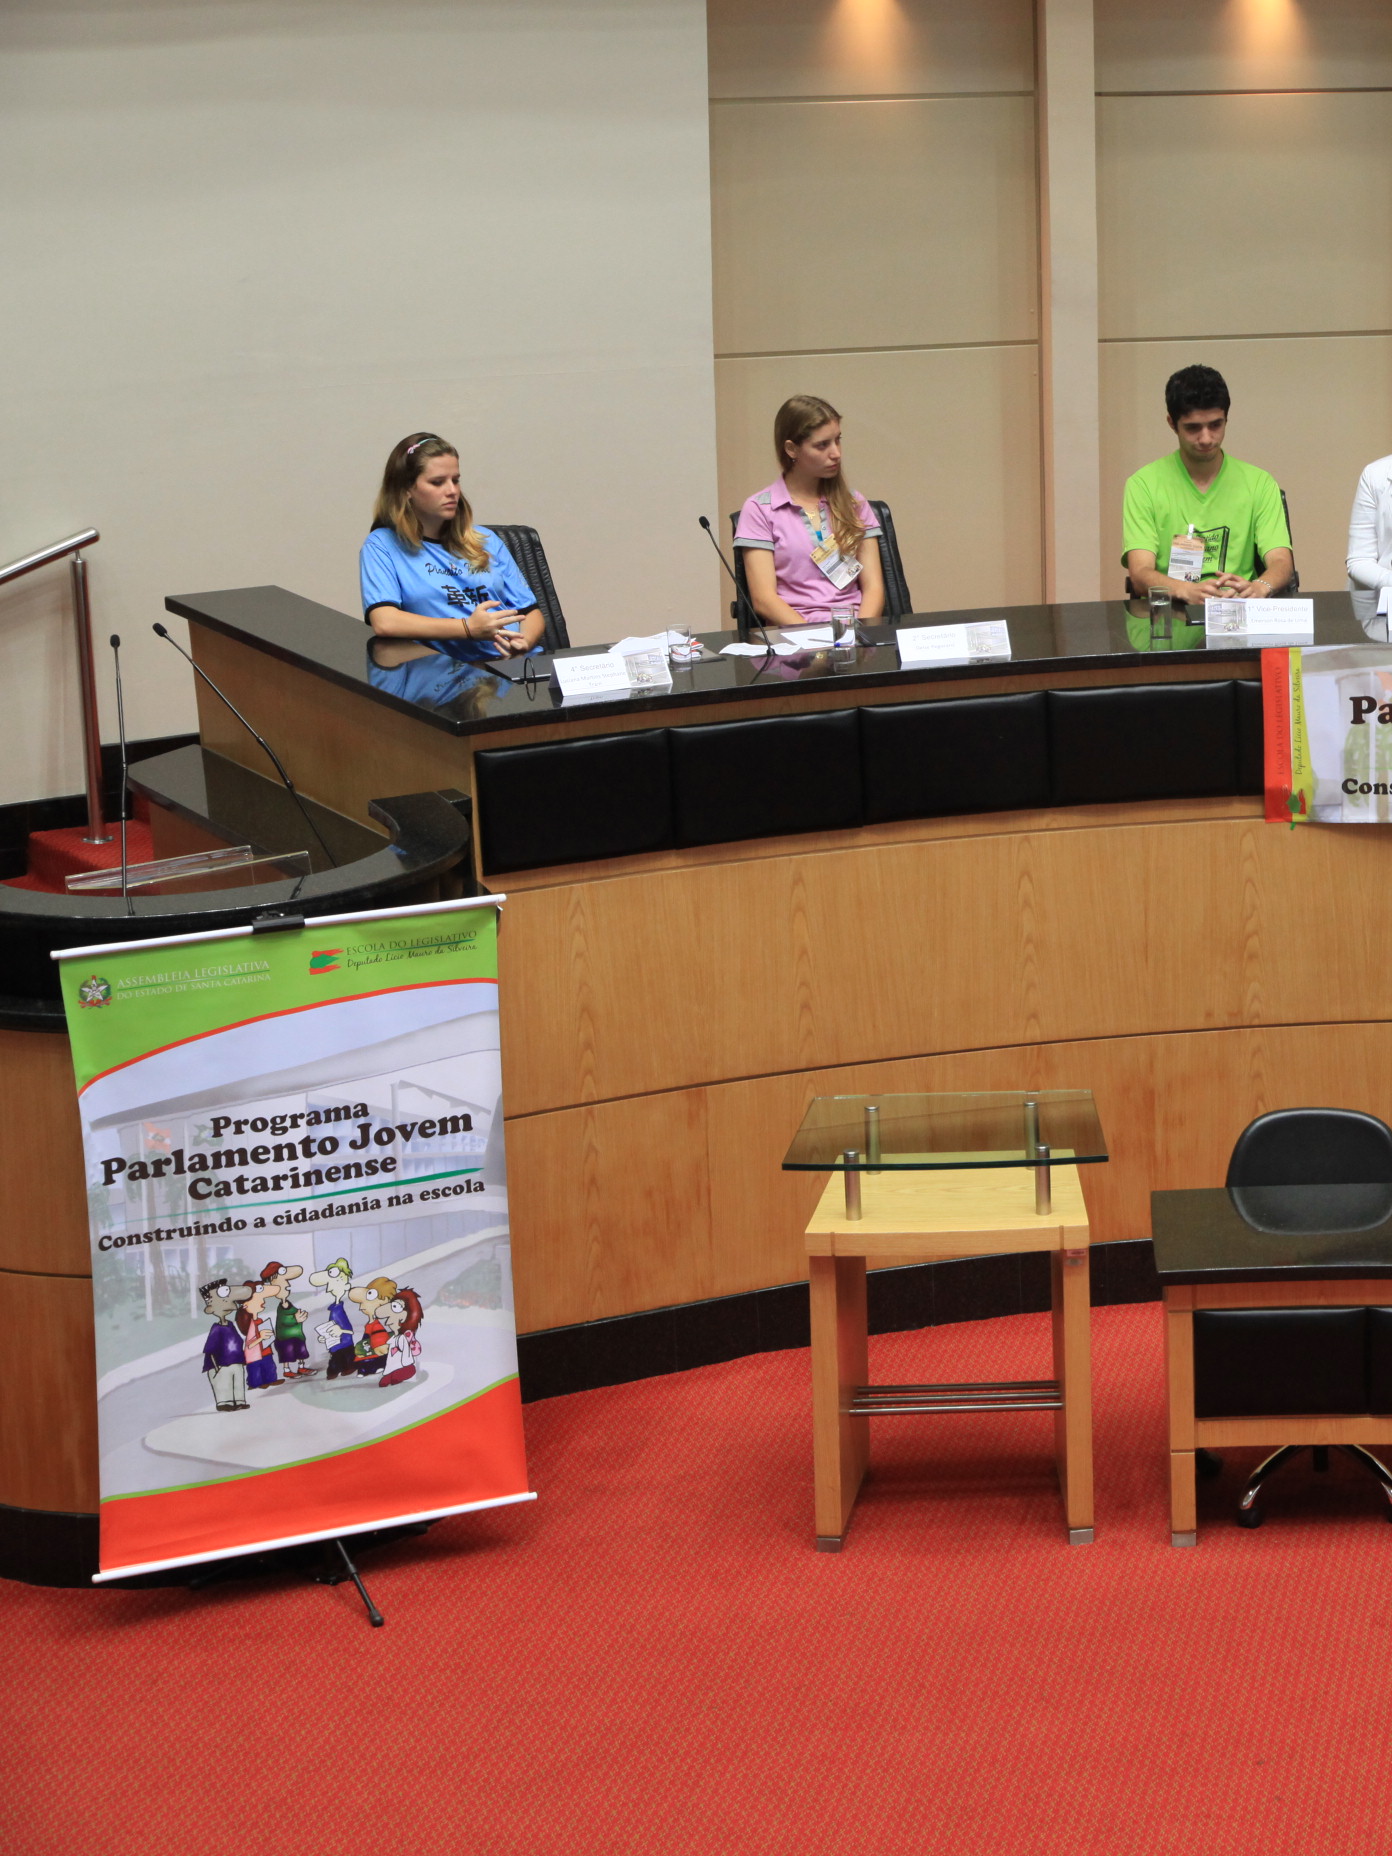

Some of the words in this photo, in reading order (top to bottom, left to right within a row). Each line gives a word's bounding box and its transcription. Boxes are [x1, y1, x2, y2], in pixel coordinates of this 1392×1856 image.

[579, 662, 615, 672] Secretário
[346, 944, 386, 956] ESCOLA
[389, 940, 407, 949] DO
[410, 930, 477, 947] LEGISLATIVO
[347, 954, 383, 971] Deputado
[408, 950, 433, 959] Mauro
[434, 946, 445, 955] da
[448, 944, 478, 954] Silveira
[117, 970, 191, 989] ASSEMBLEIA
[195, 960, 270, 978] LEGISLATIVA
[117, 991, 133, 1000] DO
[135, 987, 173, 998] ESTADO
[175, 984, 187, 993] DE
[191, 980, 222, 991] SANTA
[223, 973, 272, 987] CATARINA
[210, 1102, 370, 1138] Programa
[101, 1134, 339, 1186] Parlamento
[349, 1112, 473, 1151] Jovem
[187, 1156, 397, 1201] Catarinense
[98, 1216, 248, 1252] Construindo
[253, 1215, 267, 1228] a
[273, 1197, 381, 1227] cidadania
[387, 1191, 414, 1207] na
[419, 1179, 485, 1202] escola
